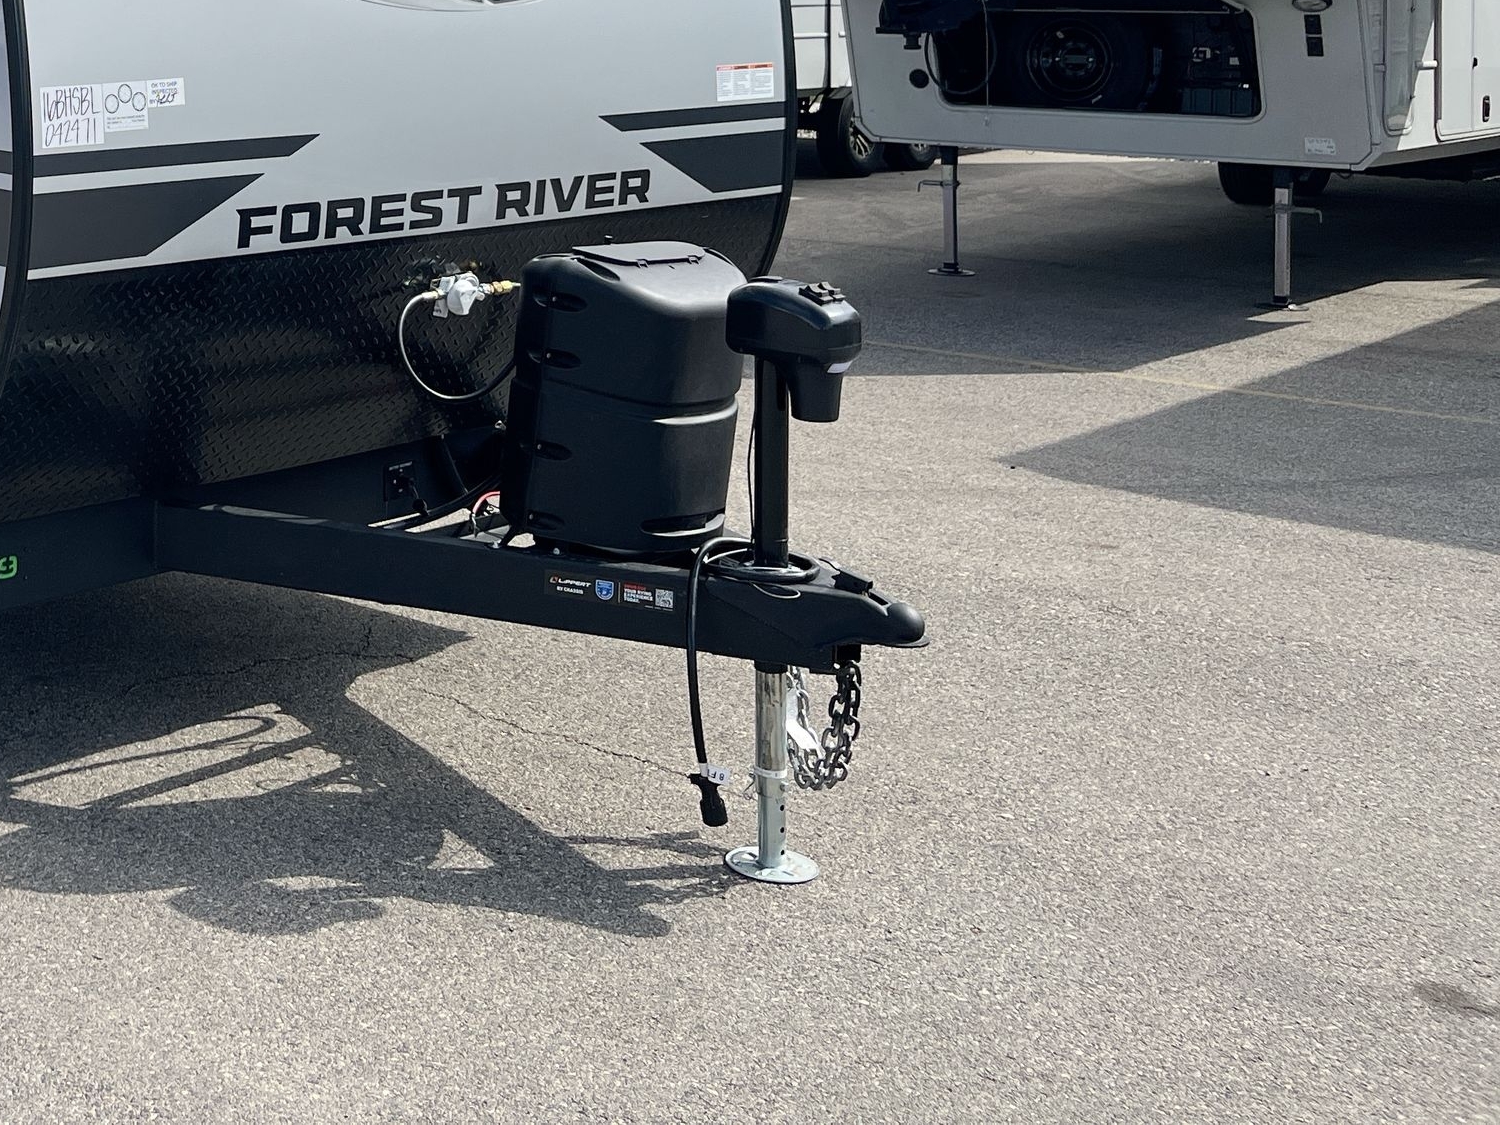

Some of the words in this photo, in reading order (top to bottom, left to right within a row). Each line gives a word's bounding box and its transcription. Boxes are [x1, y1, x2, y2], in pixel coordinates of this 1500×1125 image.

[45, 118, 97, 148] 042471
[236, 185, 483, 249] FOREST
[495, 168, 651, 220] RIVER
